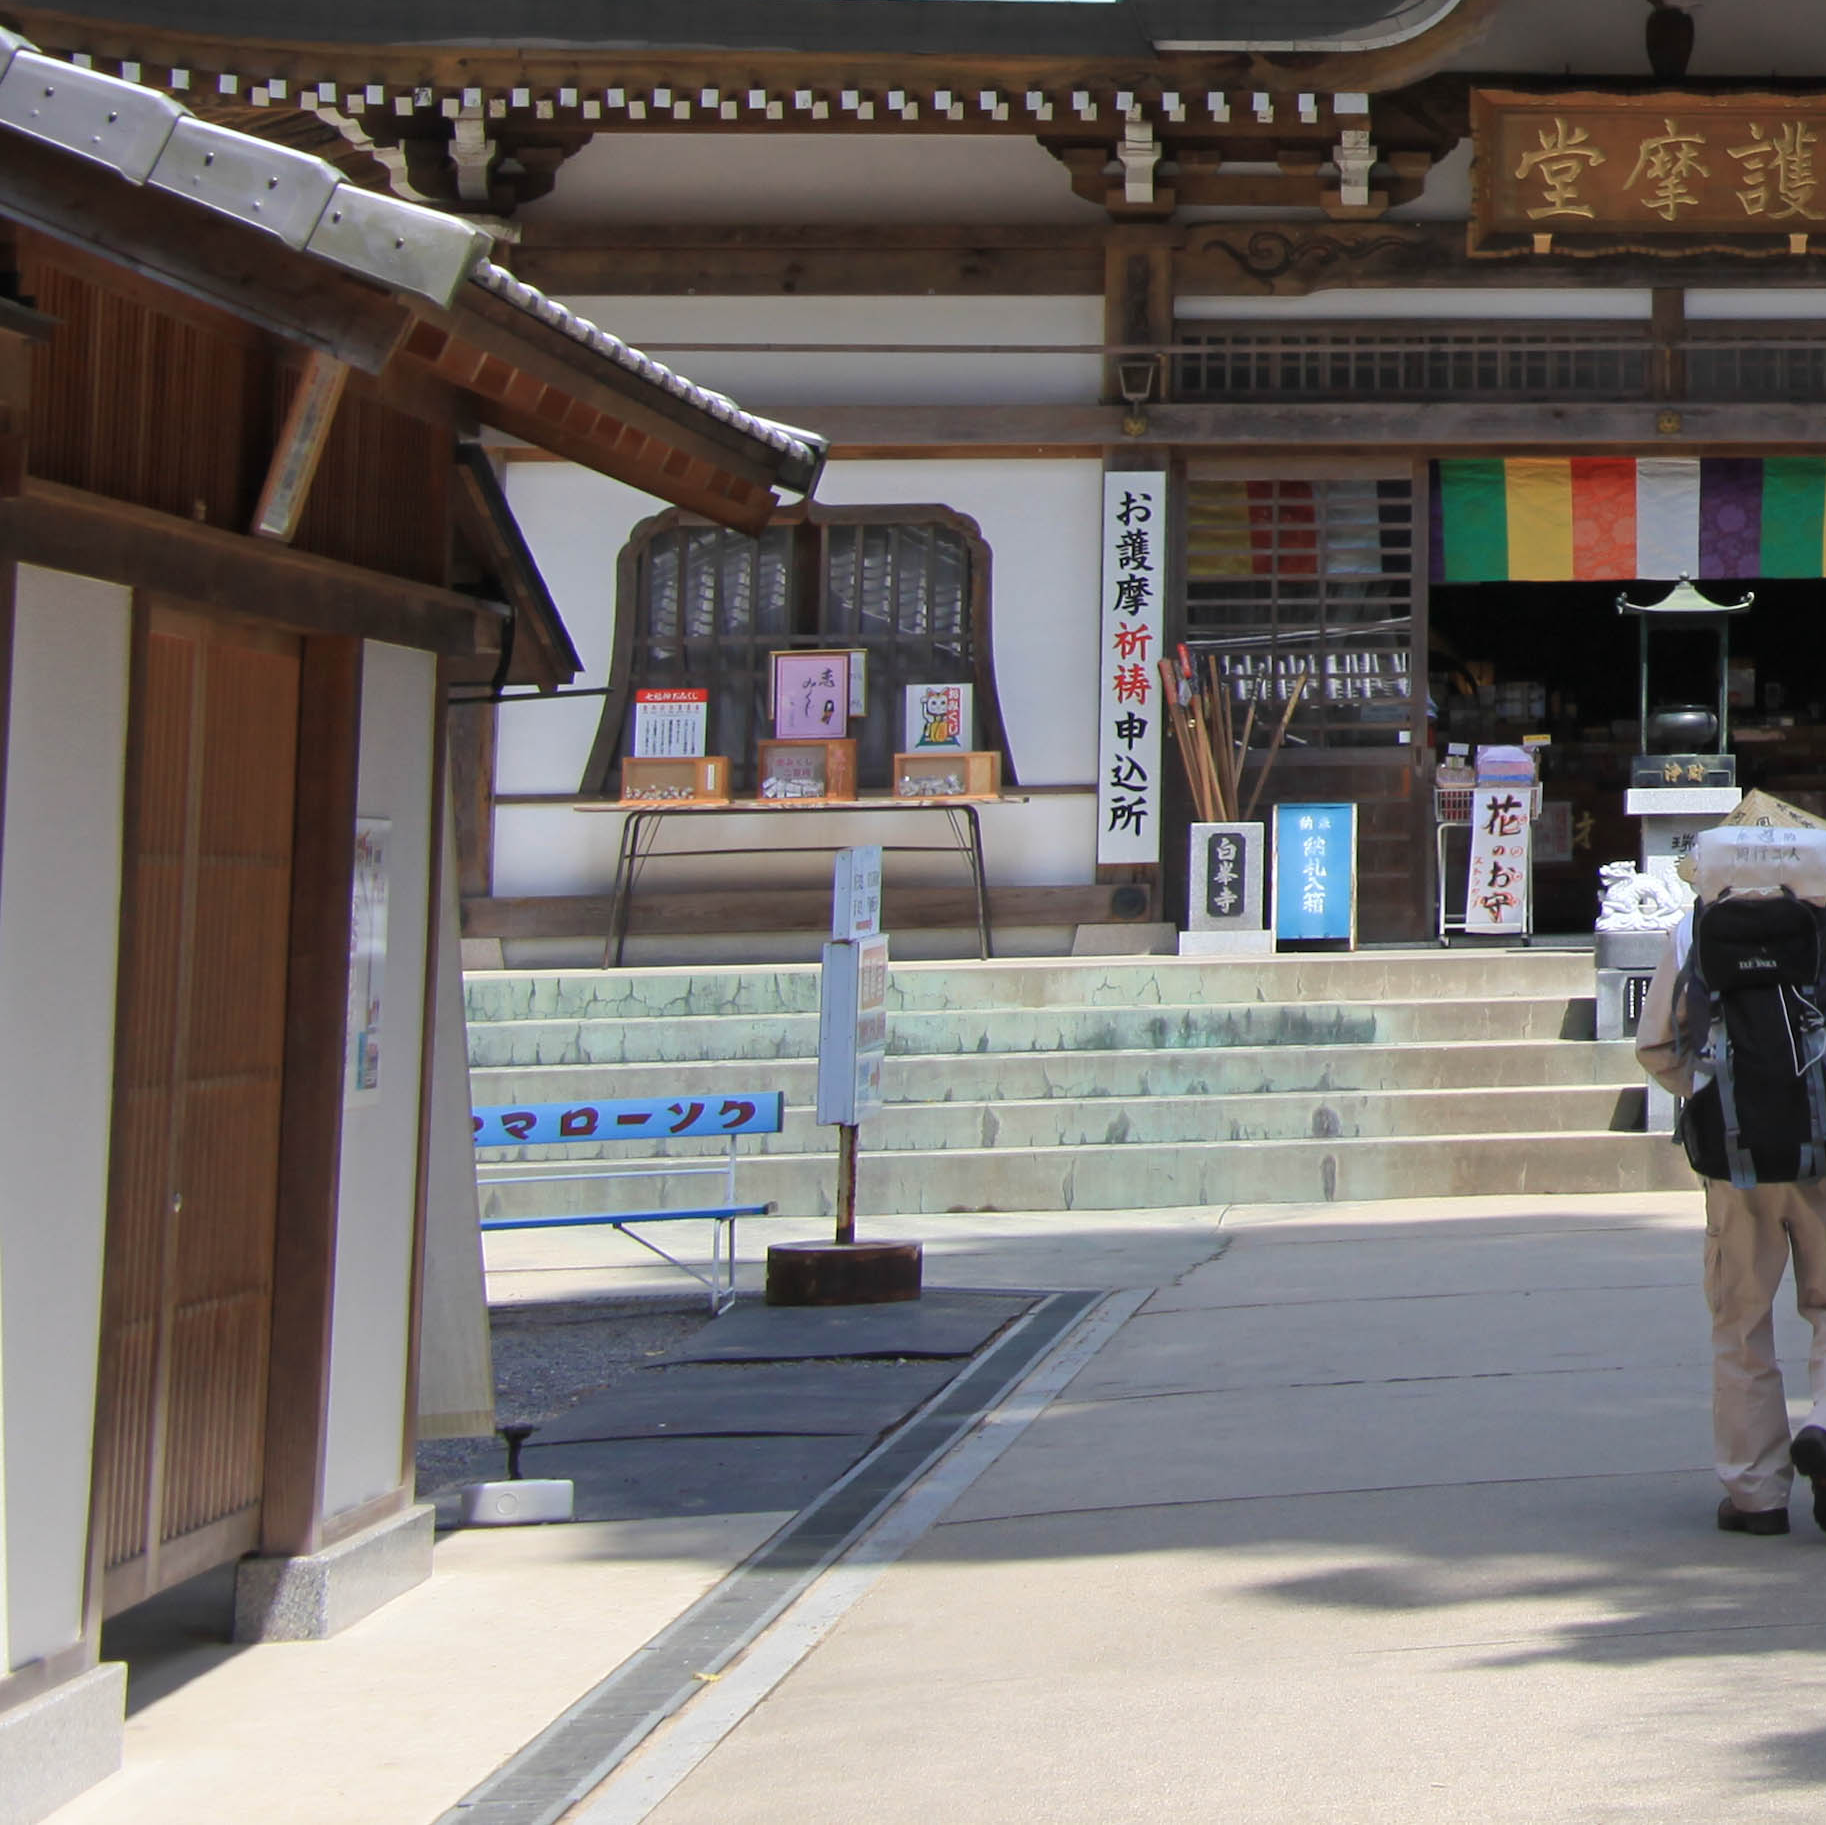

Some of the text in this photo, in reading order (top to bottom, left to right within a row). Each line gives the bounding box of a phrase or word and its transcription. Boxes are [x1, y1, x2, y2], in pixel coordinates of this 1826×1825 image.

[1108, 490, 1155, 837] お護摩祈祷申込所
[948, 687, 960, 735] おみくじ
[1213, 836, 1240, 915] 白峯寺
